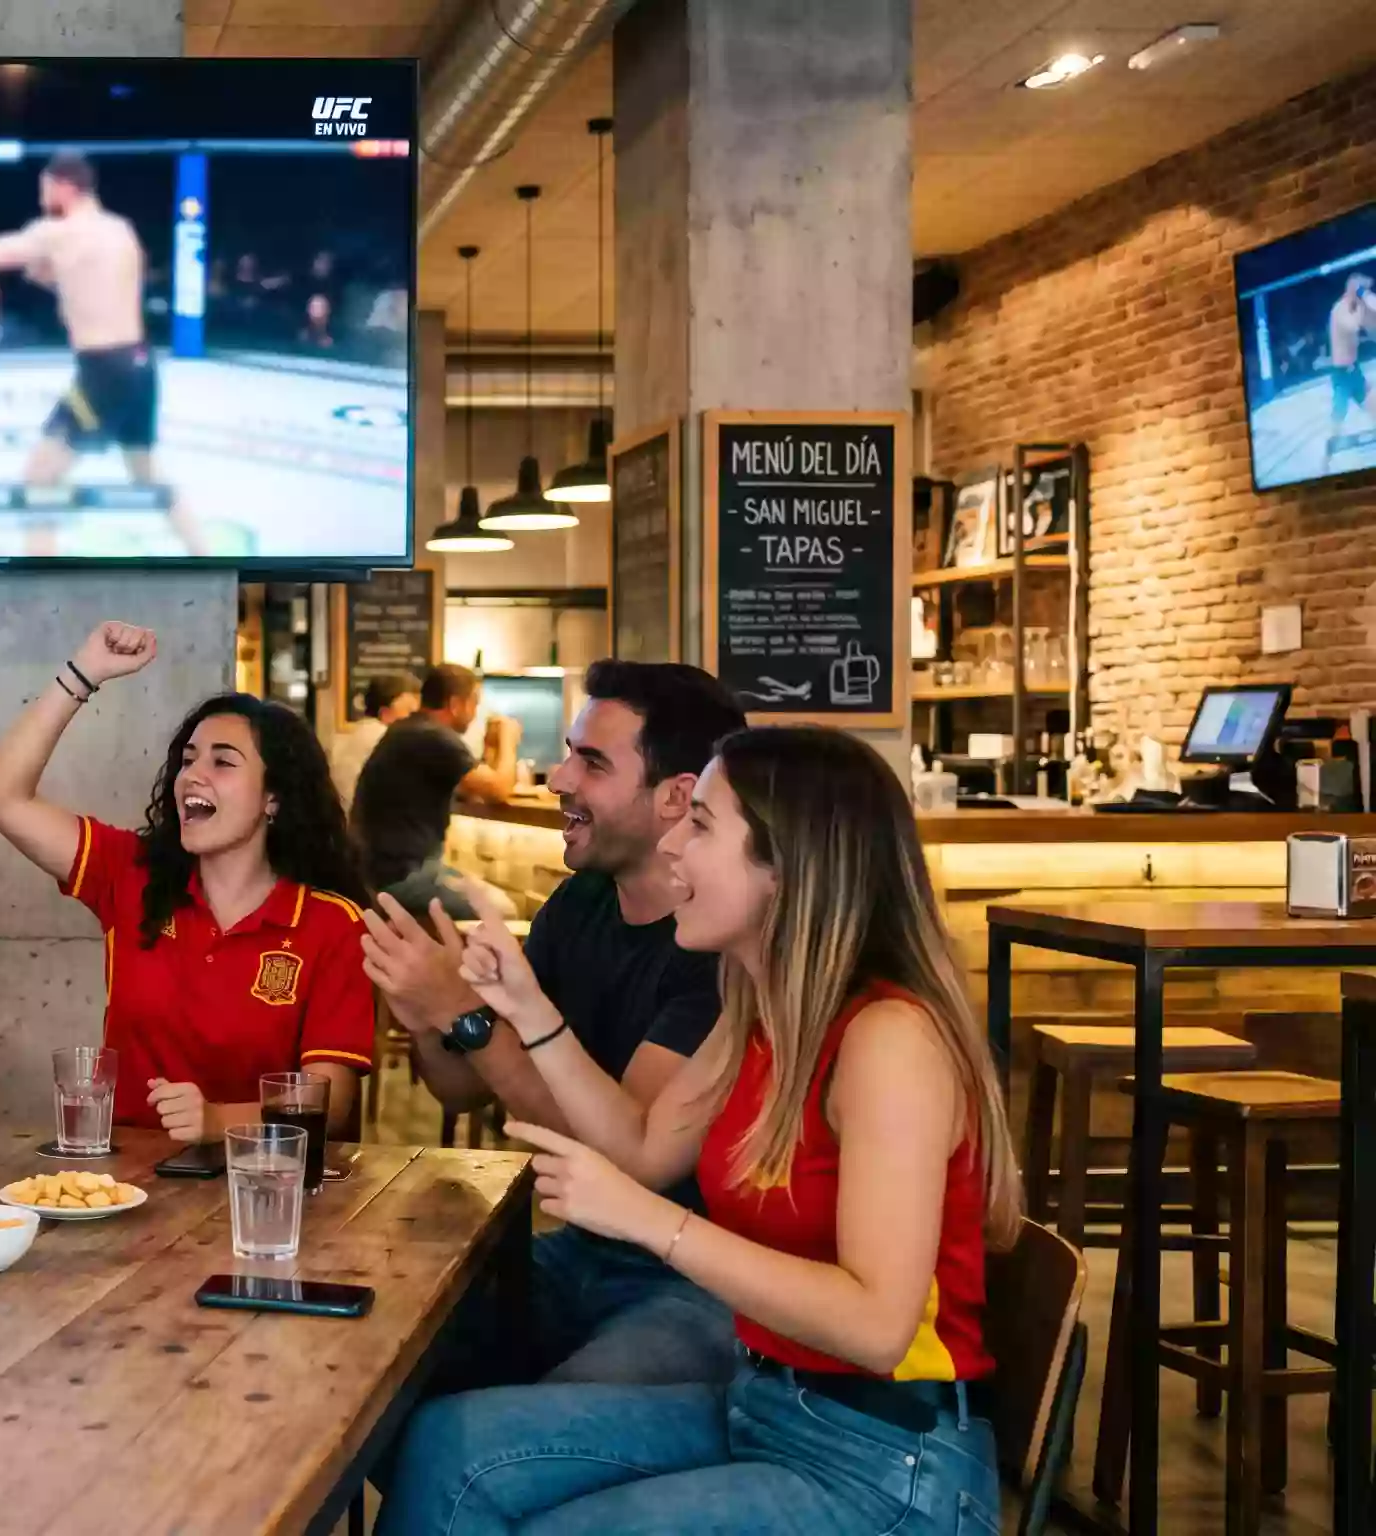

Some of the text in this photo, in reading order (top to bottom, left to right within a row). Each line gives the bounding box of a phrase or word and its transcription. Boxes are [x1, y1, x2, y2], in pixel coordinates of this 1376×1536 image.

[311, 97, 373, 119] UFC
[315, 122, 367, 136] EN VIVO
[731, 435, 882, 476] MENÚ DEL DÍA
[743, 497, 869, 526] SAN MIGUEL
[757, 536, 845, 565] TAPAS
